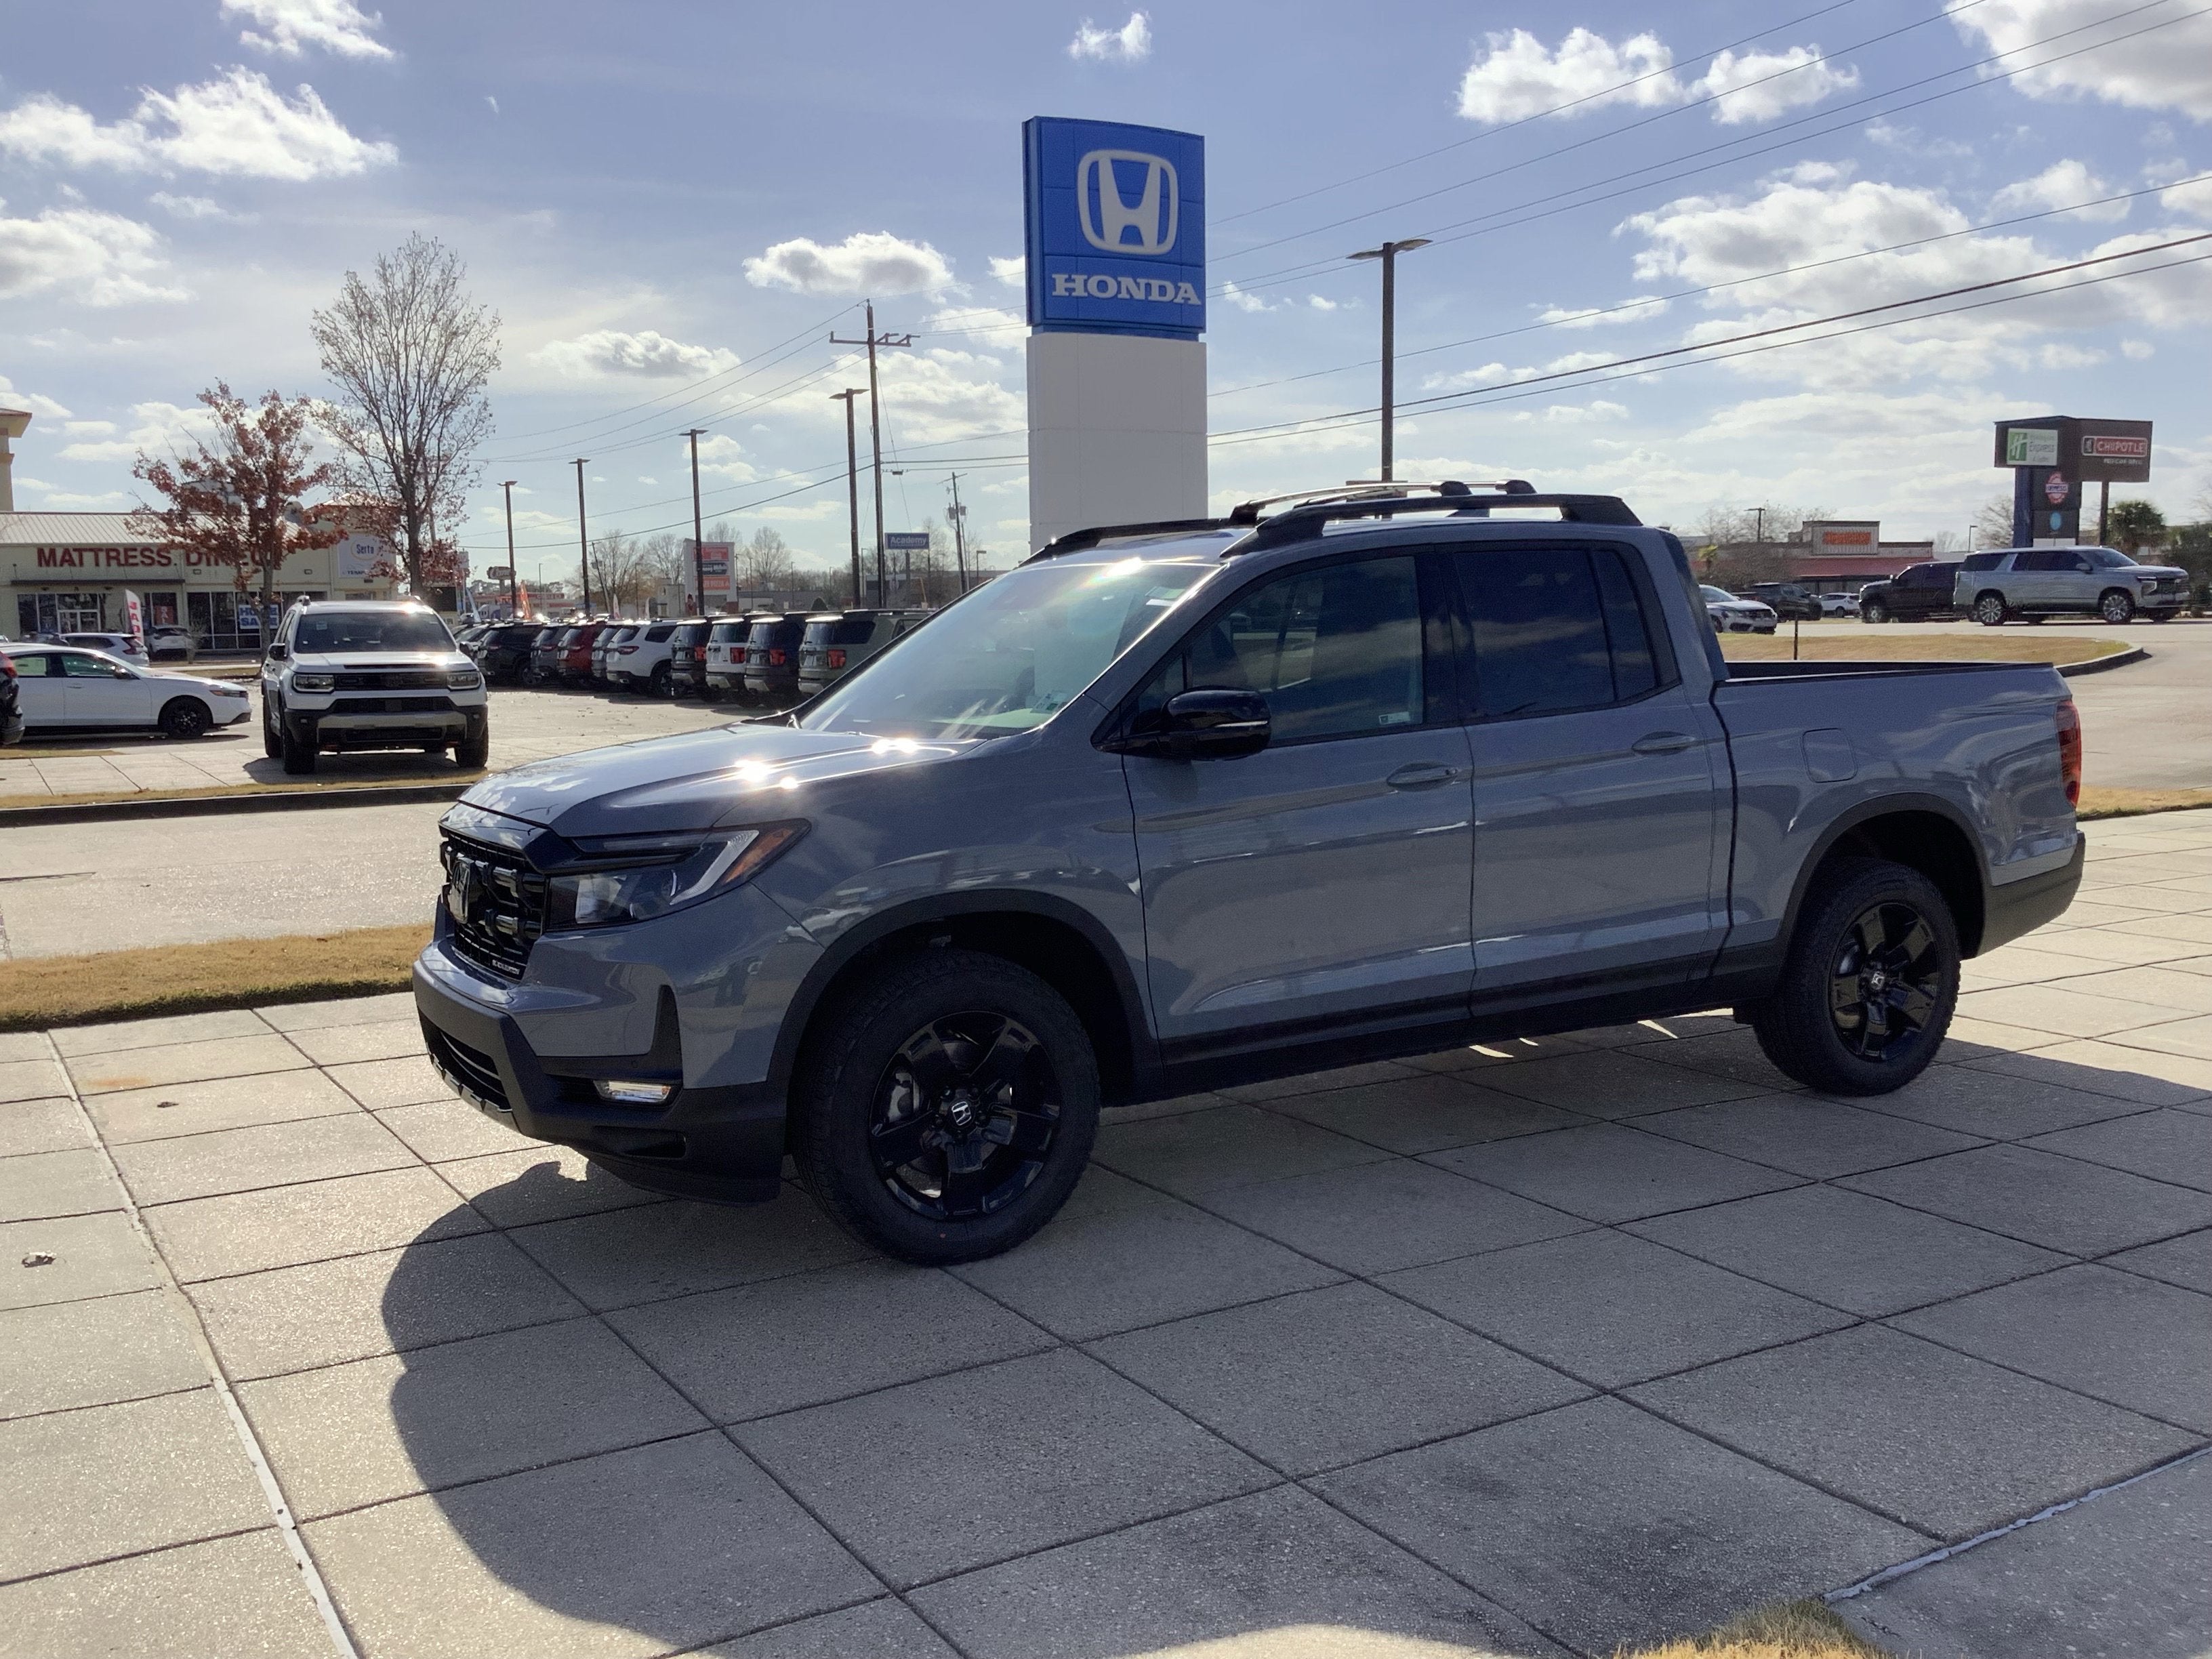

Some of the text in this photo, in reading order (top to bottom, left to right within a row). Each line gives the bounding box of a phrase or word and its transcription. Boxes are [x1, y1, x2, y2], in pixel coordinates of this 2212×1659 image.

[1052, 273, 1202, 306] HONDA
[2097, 441, 2146, 453] CHIPOTLE
[890, 535, 927, 546] Academy
[37, 547, 171, 568] MATTRESS
[241, 617, 278, 626] SAE
